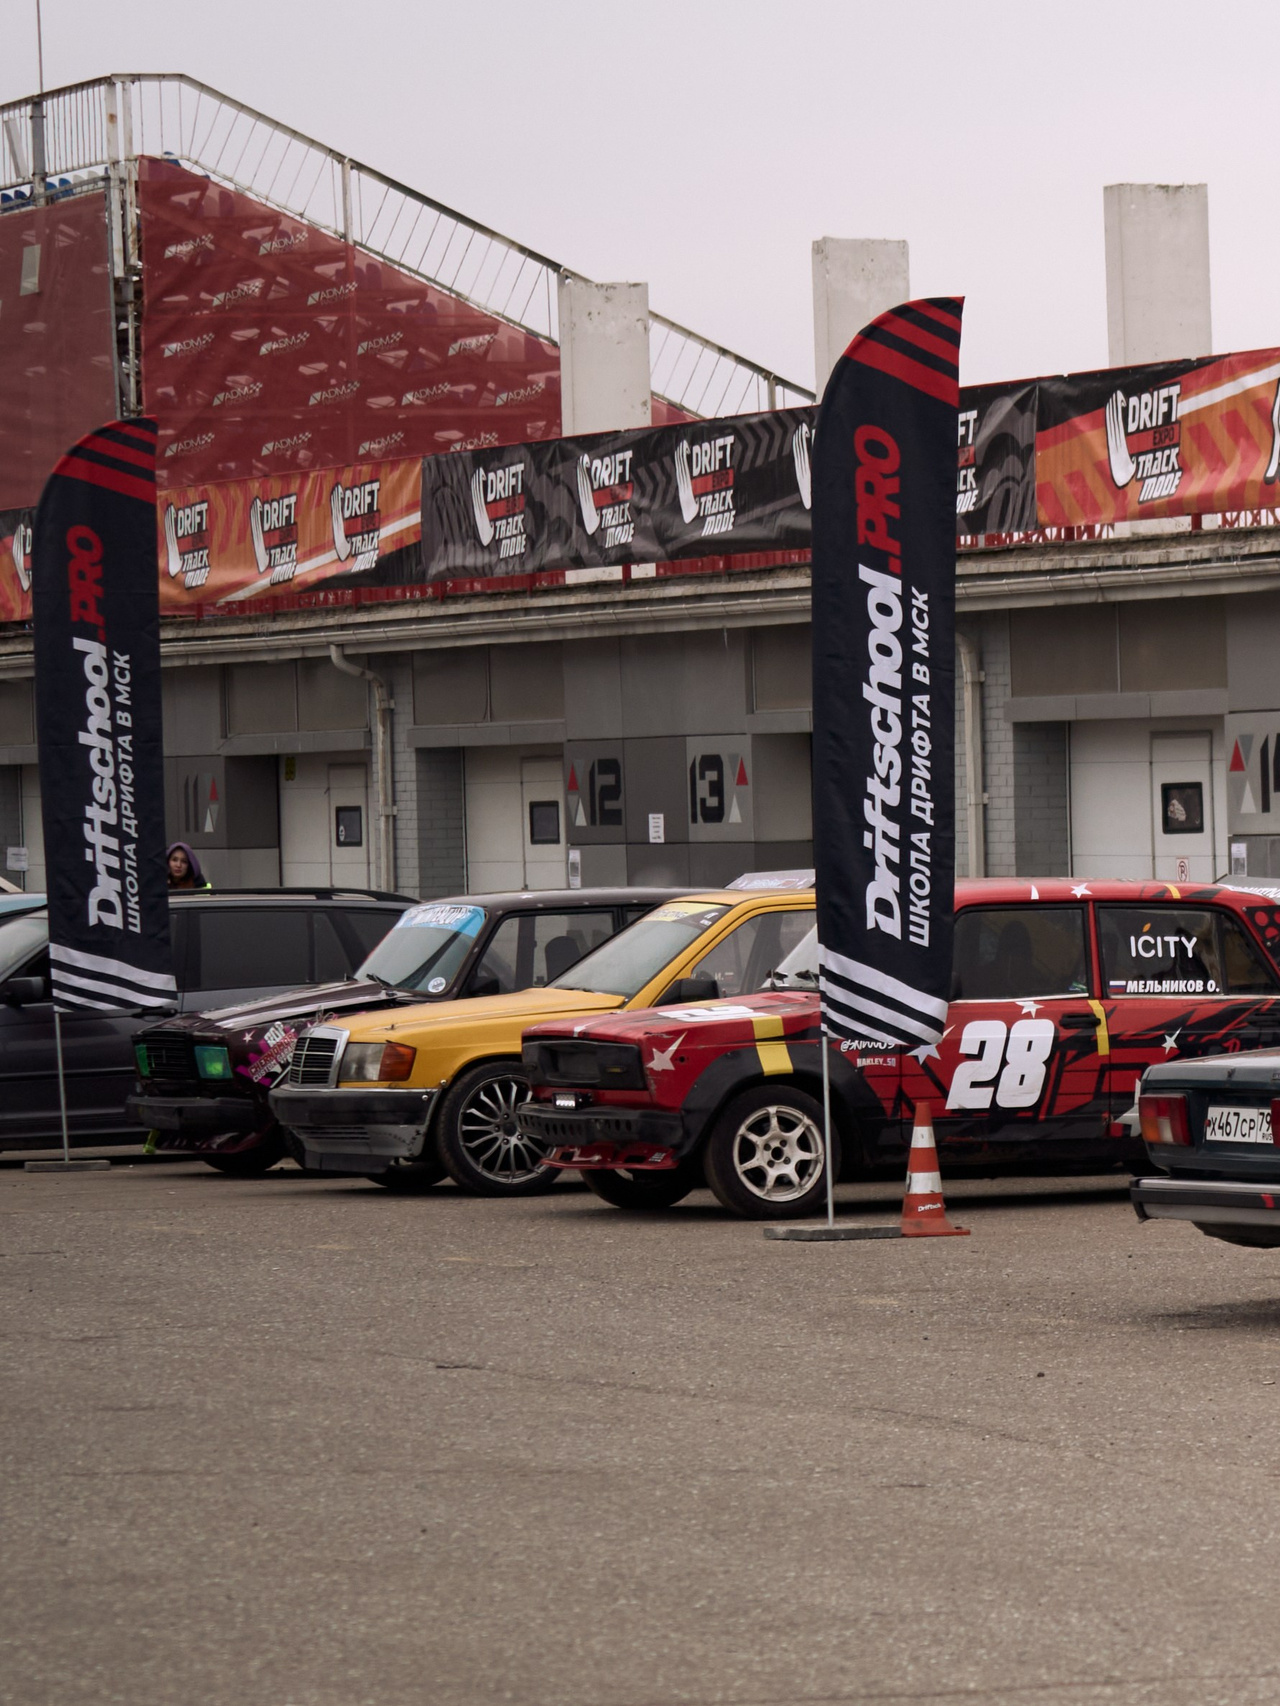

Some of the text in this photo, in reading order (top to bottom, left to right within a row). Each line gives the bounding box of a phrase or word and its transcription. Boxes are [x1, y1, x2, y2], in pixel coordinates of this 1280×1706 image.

[177, 237, 206, 253] ADM
[270, 236, 299, 251] ADM
[225, 286, 253, 301] ADM
[320, 285, 348, 300] ADM
[177, 336, 204, 350] ADM
[272, 336, 299, 350] ADM
[370, 335, 393, 350] ADM
[462, 336, 485, 350] ADM
[225, 386, 253, 401] ADM
[321, 385, 349, 400] ADM
[415, 386, 441, 400] ADM
[509, 386, 534, 401] ADM
[1128, 384, 1181, 432] DRIFT
[177, 436, 201, 452] ADM
[273, 435, 299, 451] ADM
[371, 435, 394, 451] ADM
[462, 434, 486, 450] ADM
[1153, 429, 1175, 446] EXPO
[692, 435, 734, 477] DRIFT
[1138, 447, 1179, 479] TRACK
[591, 451, 633, 488] DRIFT
[487, 463, 525, 503] DRIFT
[1139, 473, 1181, 502] MODE
[345, 481, 380, 516] DRIFT
[700, 490, 734, 517] TRACK
[177, 502, 209, 537] DRIFT
[264, 495, 297, 530] DRIFT
[601, 504, 631, 529] TRACK
[496, 515, 525, 541] TRACK
[606, 524, 634, 548] MODE
[702, 513, 735, 537] MODE
[351, 530, 380, 555] TRACK
[500, 535, 527, 559] MODE
[182, 549, 209, 571] TRACK
[270, 543, 297, 565] TRACK
[352, 552, 379, 572] MODE
[185, 569, 210, 588] MODE
[271, 563, 297, 585] MODE
[907, 587, 934, 948] ШКОЛА ДРИФТА В МСК
[114, 651, 141, 935] ШКОЛА ДРИФТА В МСК
[590, 758, 623, 826] 12
[690, 753, 725, 824] 13
[1129, 935, 1197, 958] ICITY
[1126, 980, 1220, 993] МЕЛЬНИКОВ О.
[253, 1060, 276, 1082] CUSTOM
[946, 1019, 1054, 1109] 28
